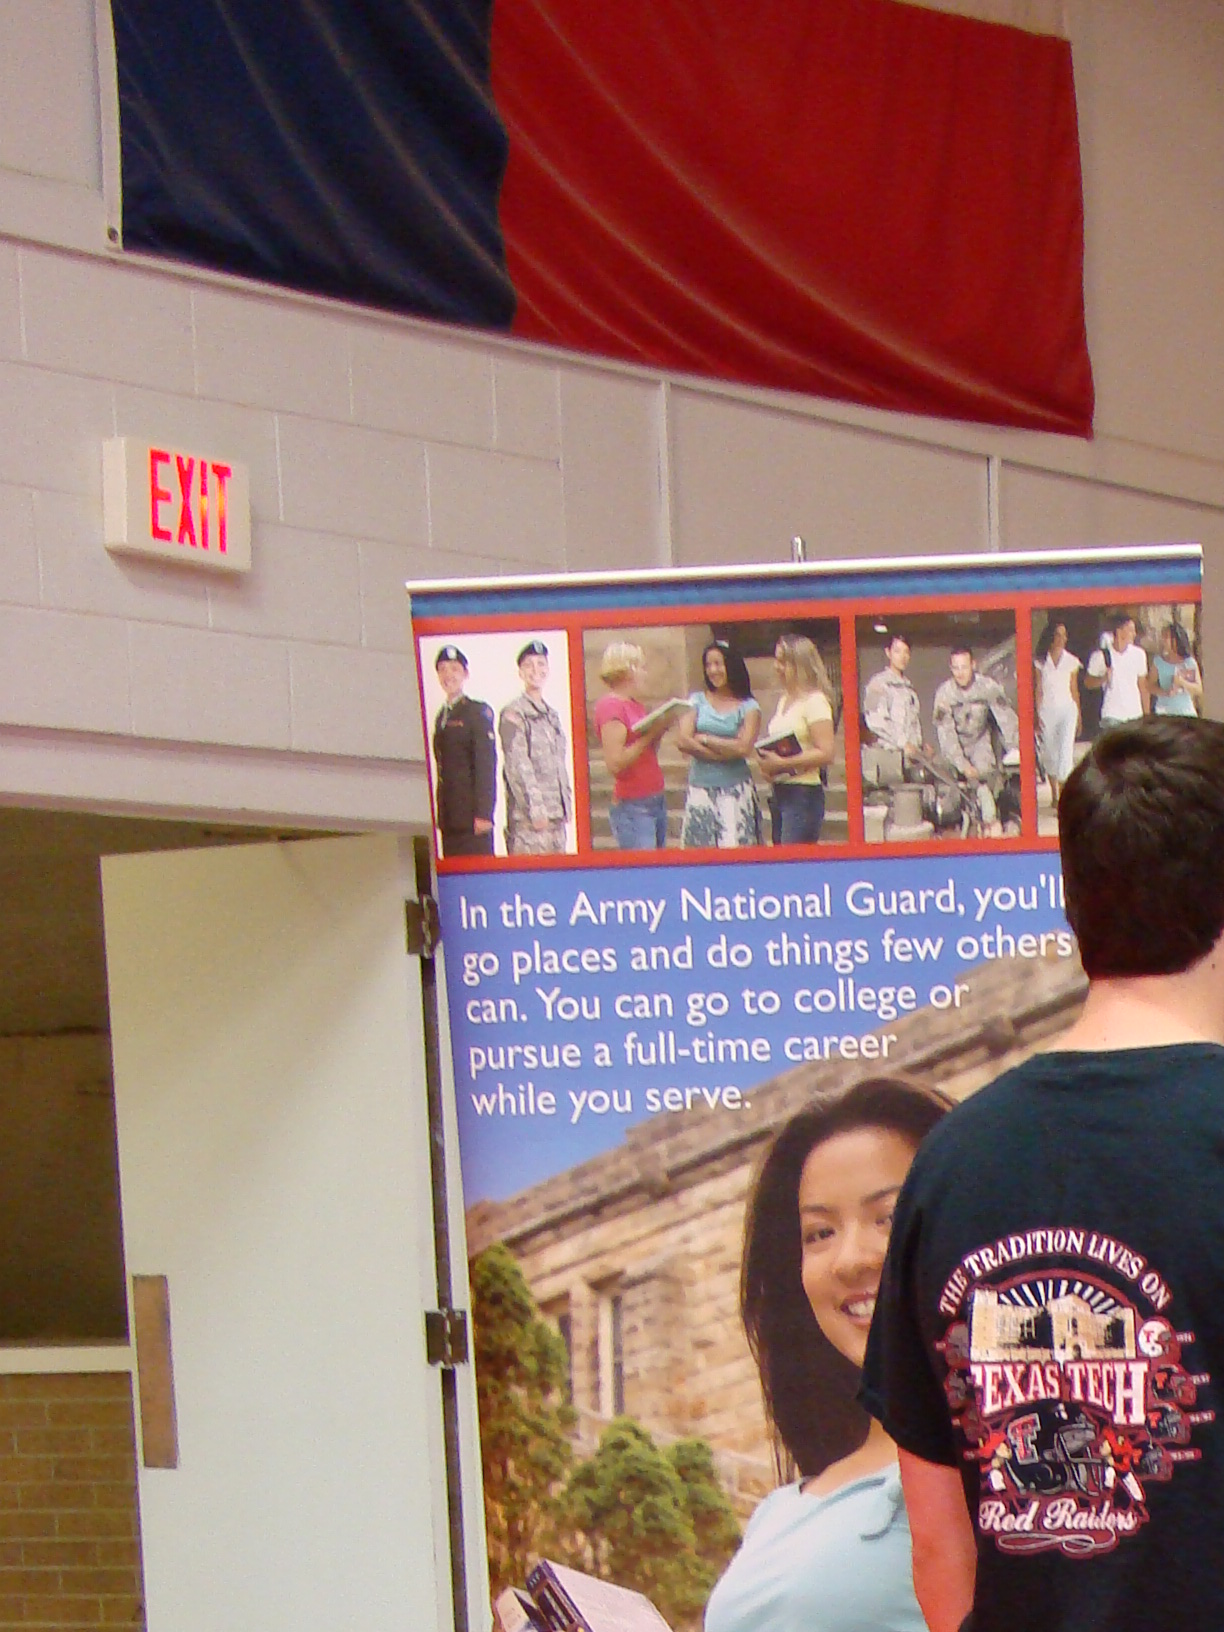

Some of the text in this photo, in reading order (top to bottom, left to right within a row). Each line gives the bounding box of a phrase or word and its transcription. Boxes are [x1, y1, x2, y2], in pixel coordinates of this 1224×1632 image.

[148, 447, 232, 555] EXIT
[459, 873, 1066, 934] In the Army National Guard, you'll
[463, 923, 1073, 987] go places and do things few others
[466, 977, 970, 1027] can. You can go to college or
[469, 1030, 898, 1080] pursue a full-time career
[471, 1082, 752, 1124] while you serve.
[938, 1229, 1173, 1317] THE TRADITION LIVES ON
[970, 1362, 1149, 1425] TEXAS TECH
[979, 1498, 1138, 1533] Red Raiders
